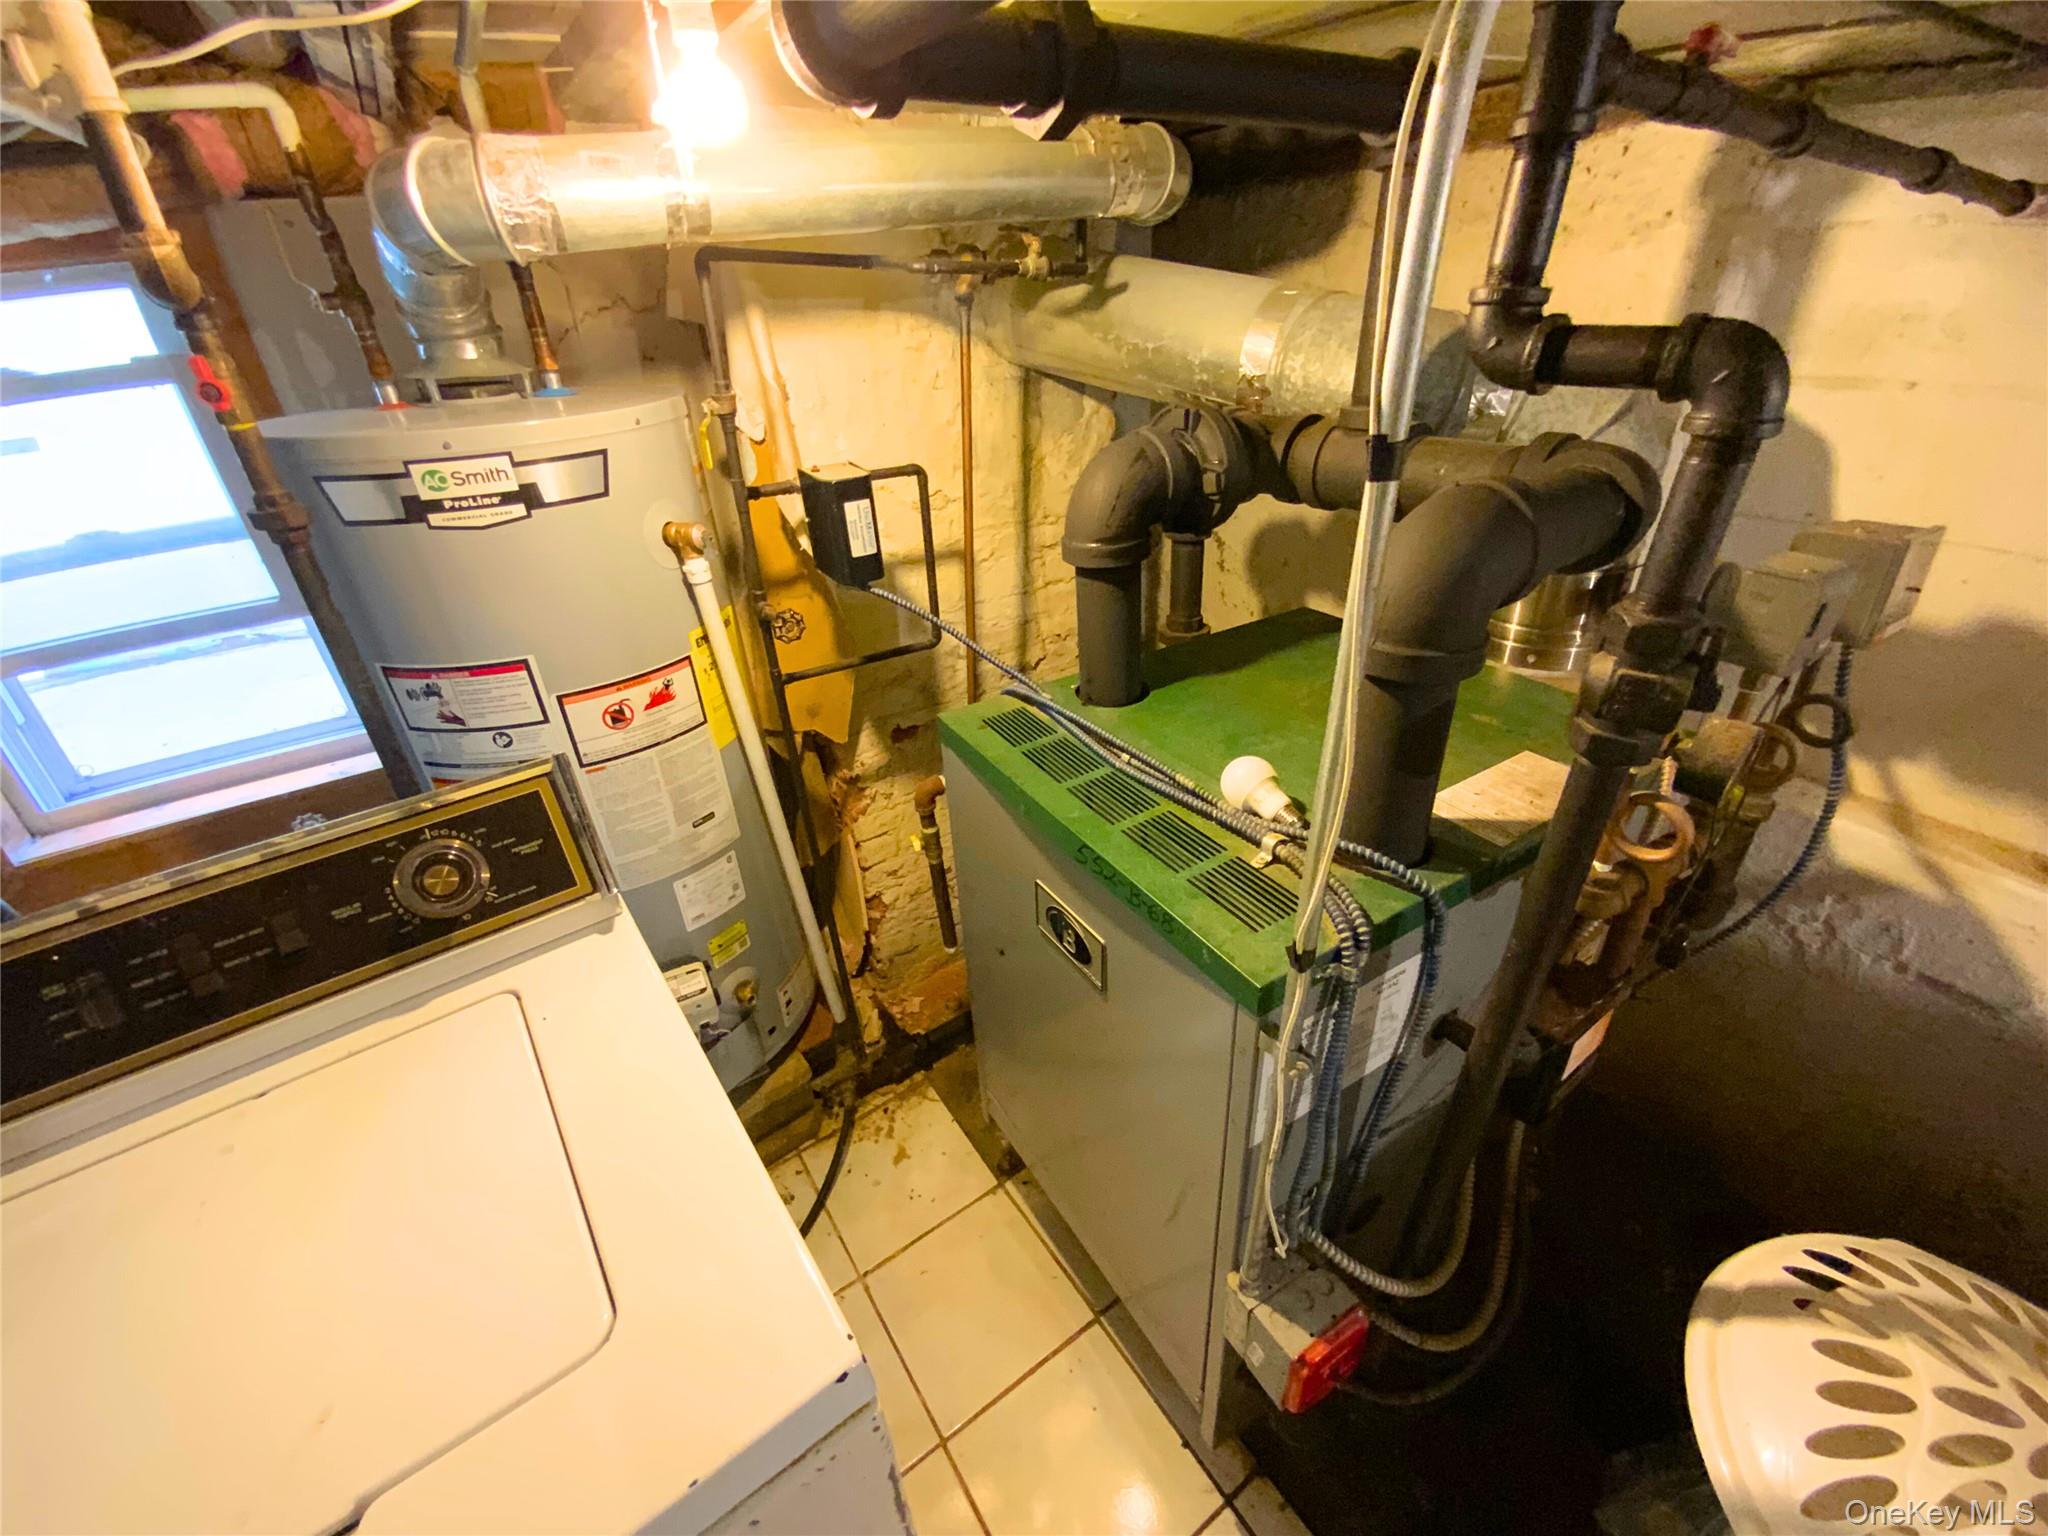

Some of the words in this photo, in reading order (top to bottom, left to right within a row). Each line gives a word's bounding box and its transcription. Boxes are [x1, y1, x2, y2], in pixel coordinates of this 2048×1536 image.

[423, 471, 449, 490] AO
[450, 466, 510, 487] Smith
[443, 496, 502, 509] ProLine
